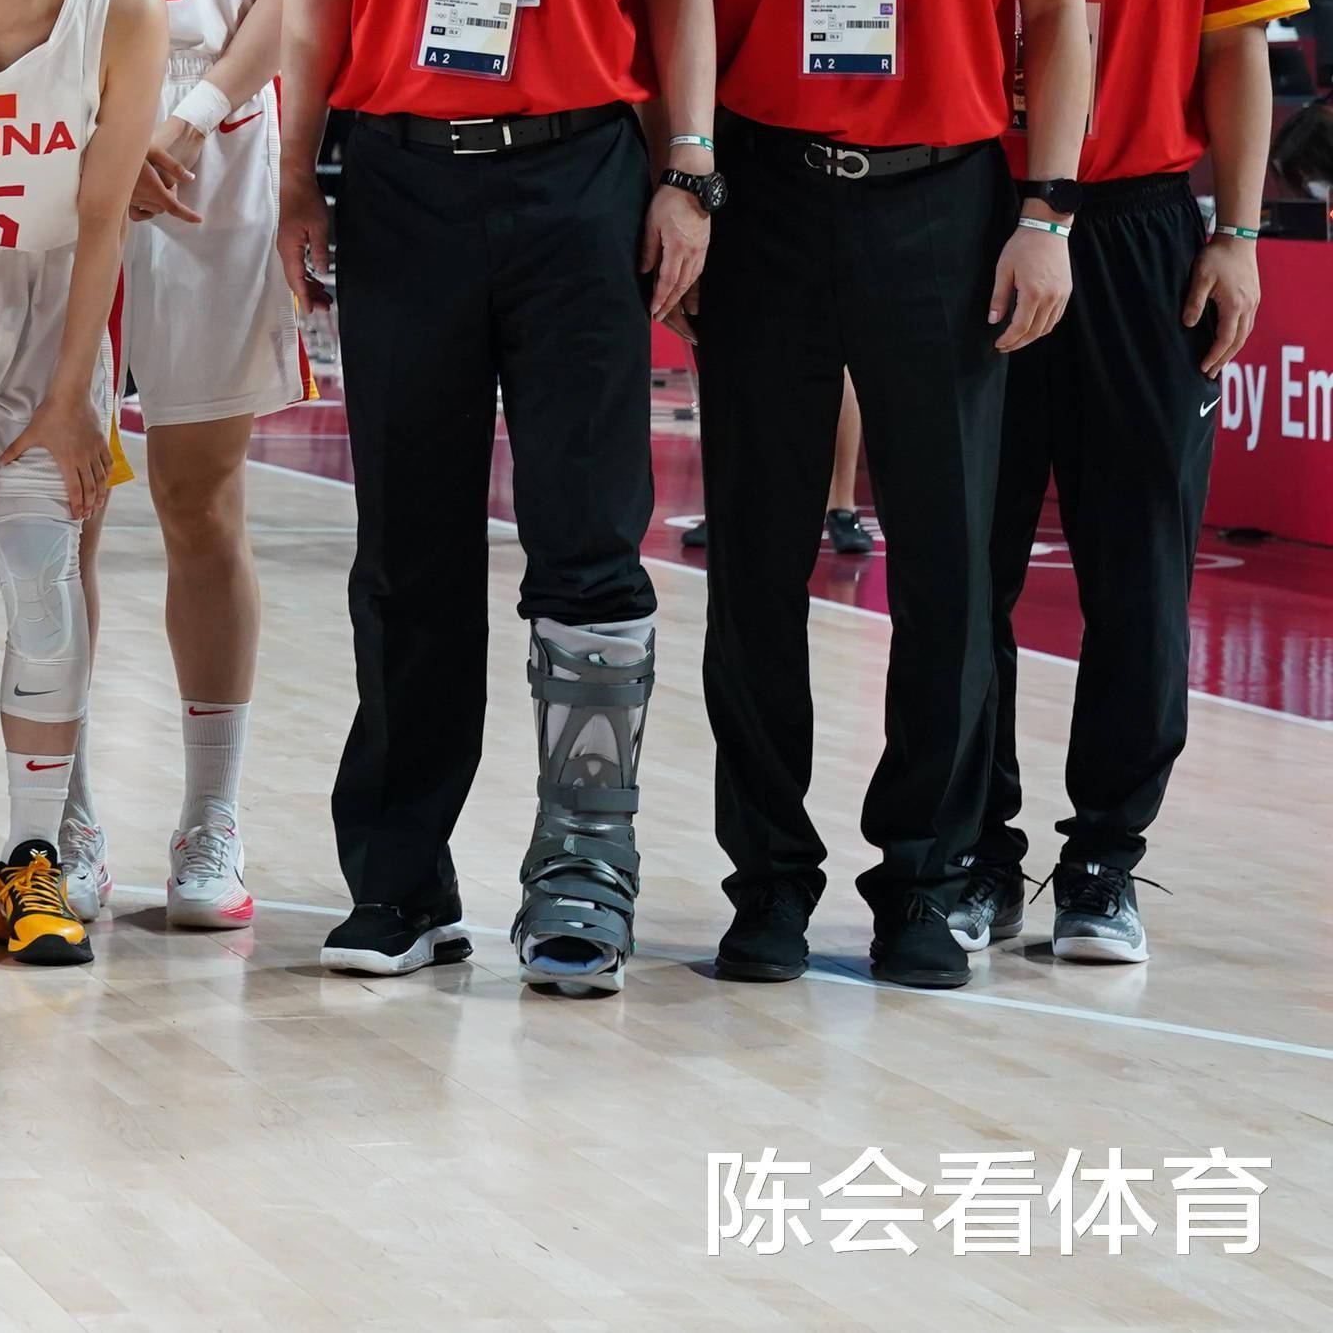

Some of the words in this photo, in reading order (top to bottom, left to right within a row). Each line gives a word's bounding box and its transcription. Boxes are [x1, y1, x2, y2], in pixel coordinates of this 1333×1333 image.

[429, 52, 437, 63] A
[442, 53, 450, 64] 2
[493, 59, 501, 70] R
[813, 59, 822, 70] A
[828, 58, 835, 69] 2
[881, 59, 889, 70] R
[1221, 361, 1267, 451] by
